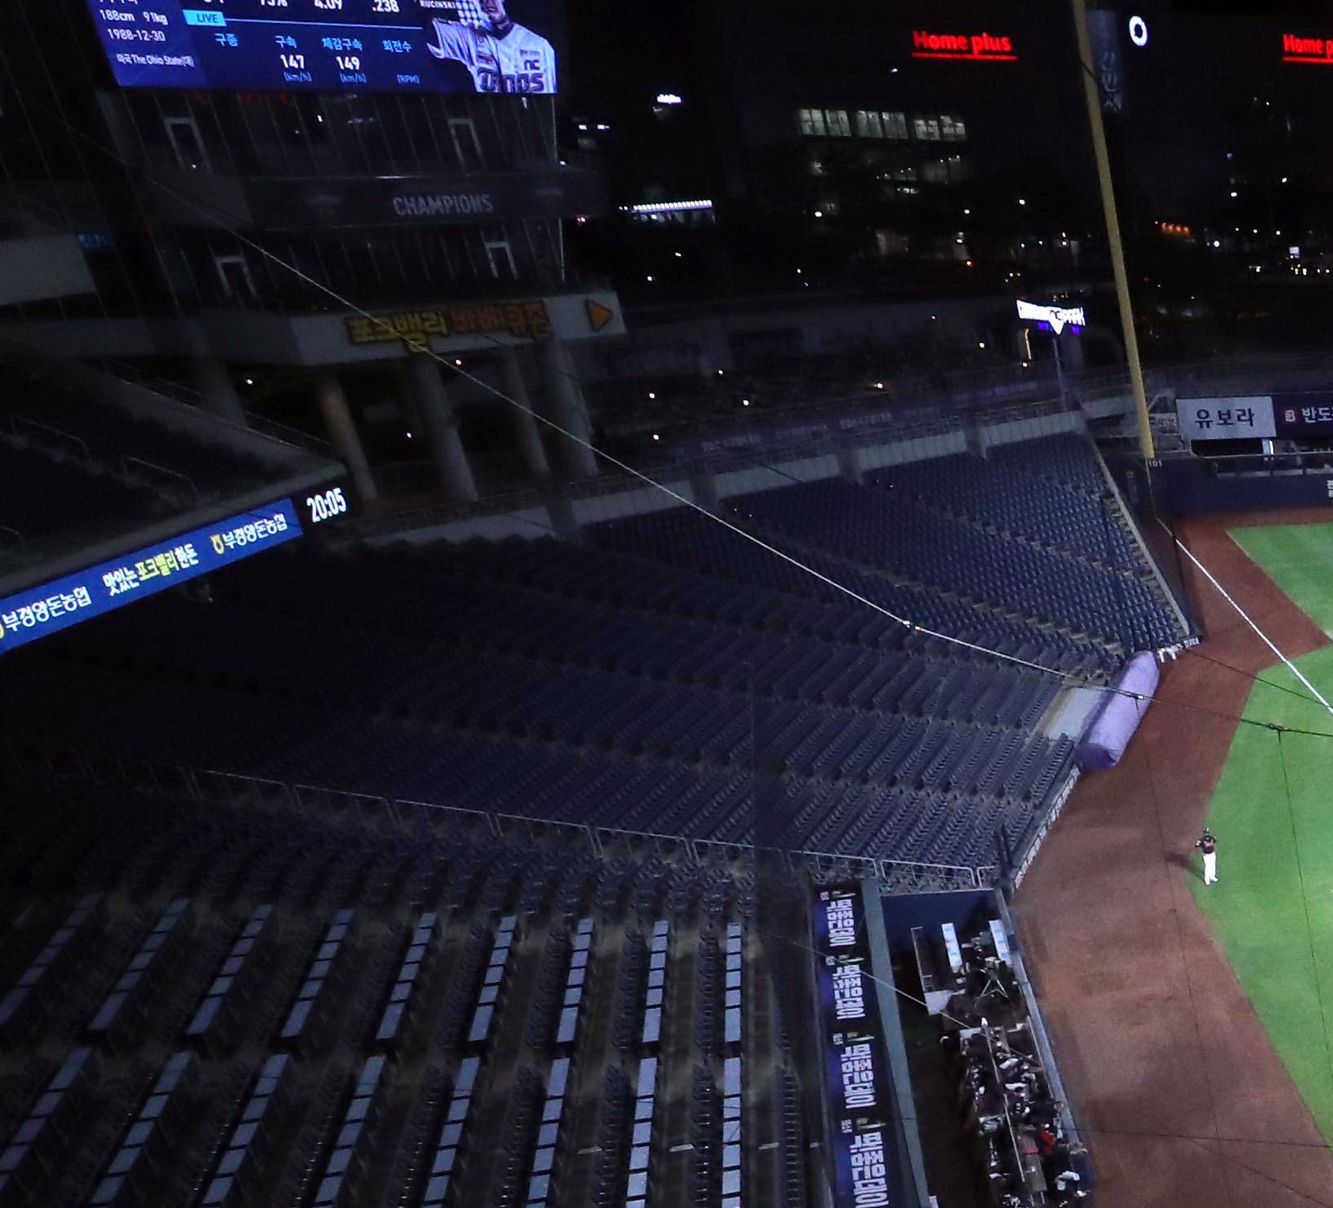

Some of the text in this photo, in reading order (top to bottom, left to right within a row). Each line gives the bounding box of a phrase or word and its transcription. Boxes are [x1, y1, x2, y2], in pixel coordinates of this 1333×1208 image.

[100, 9, 168, 25] 188cm 91kg
[196, 14, 218, 24] LIVE
[107, 28, 166, 42] 1988-12-30
[276, 35, 297, 48] 구속
[913, 31, 1012, 55] Home plus
[1283, 33, 1323, 55] Home
[280, 54, 360, 71] 147 149
[393, 194, 494, 216] CHAMPIONS
[1194, 407, 1256, 429] 유보라
[306, 487, 346, 524] 20:05
[222, 513, 288, 549] 부경양돈농협
[102, 566, 140, 597] 맛있는
[2, 585, 92, 633] 부경양돈농협
